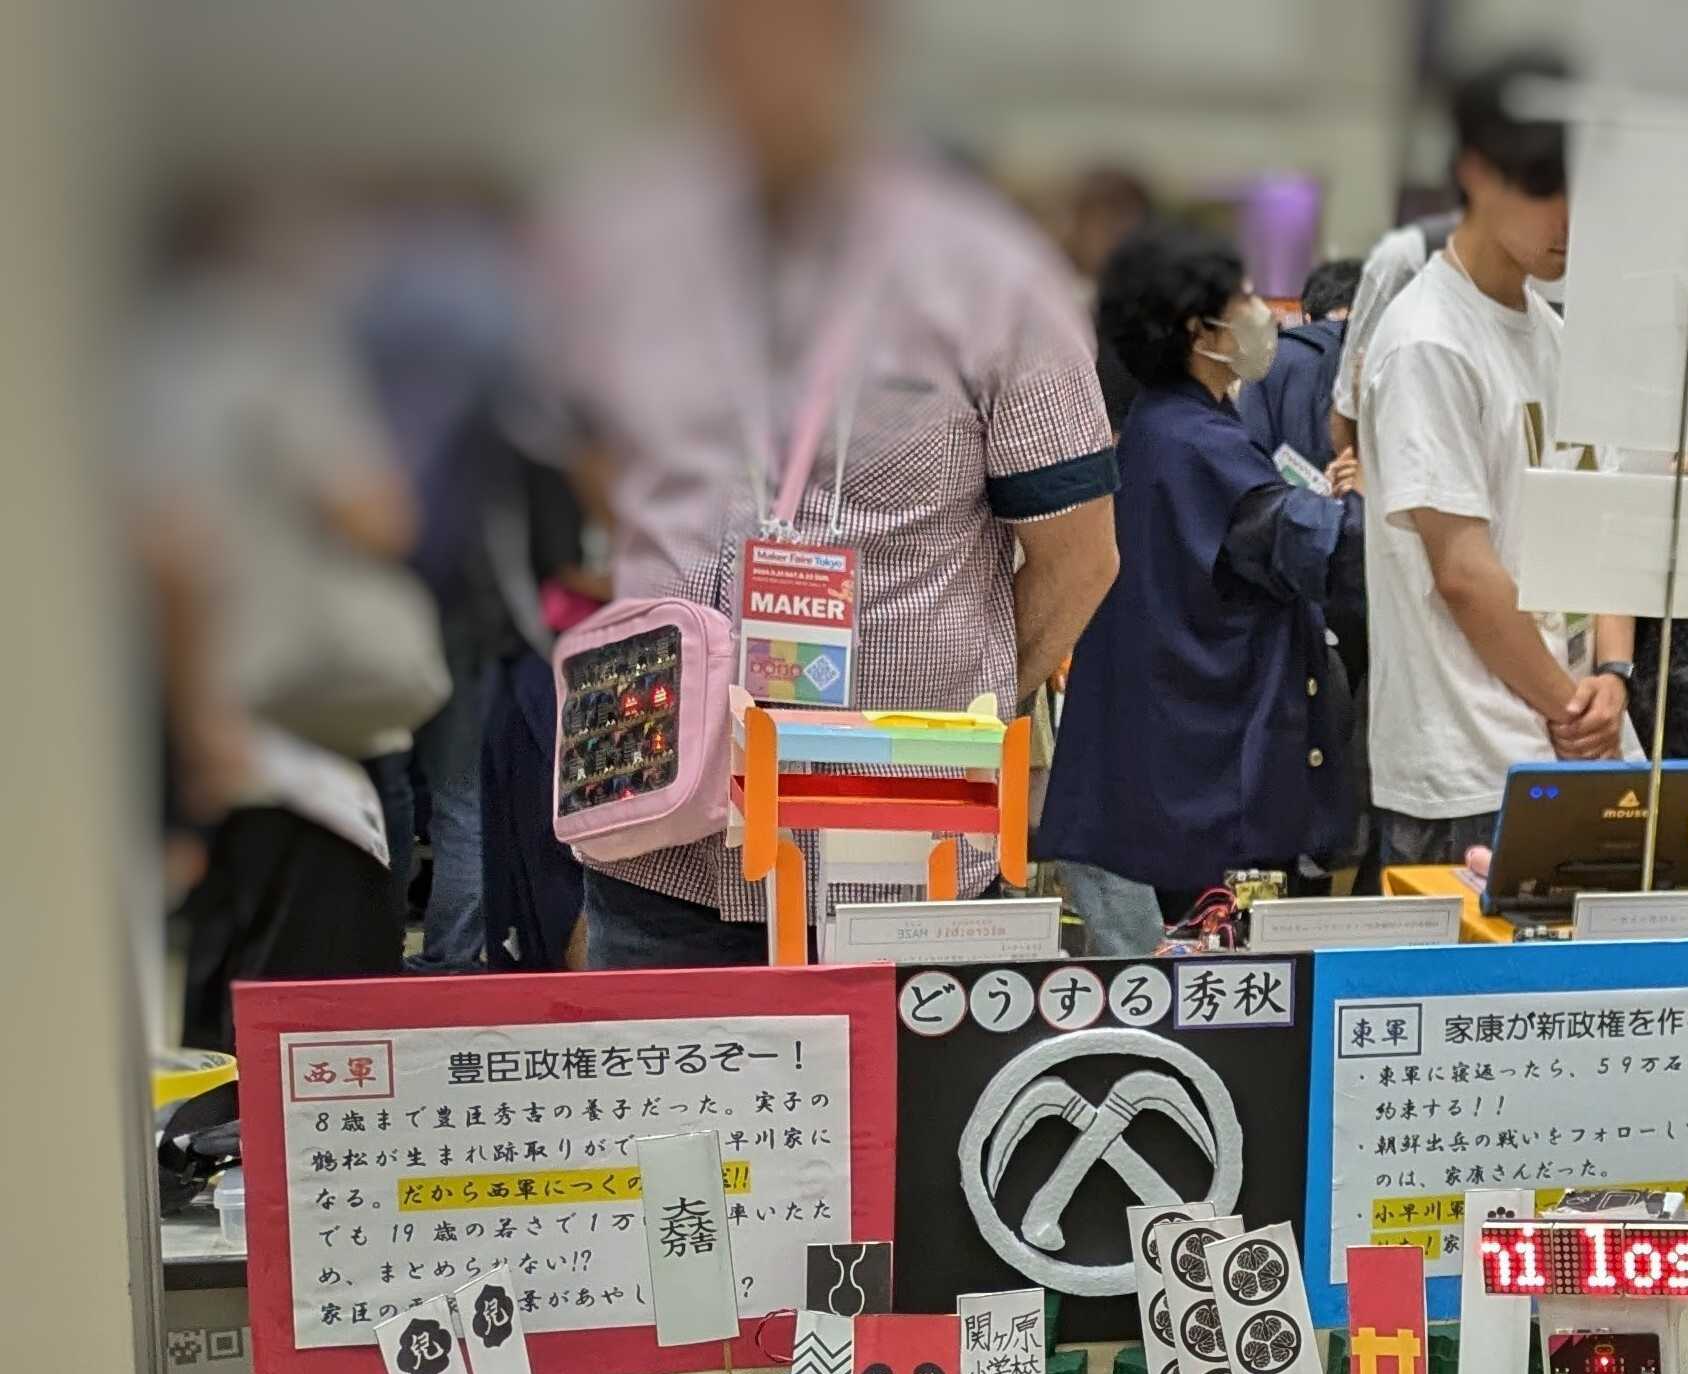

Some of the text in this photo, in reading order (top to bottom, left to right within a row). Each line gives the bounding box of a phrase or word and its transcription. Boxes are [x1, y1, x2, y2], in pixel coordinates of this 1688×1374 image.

[751, 592, 845, 620] MAKER
[1351, 1017, 1409, 1047] 東軍
[303, 1056, 378, 1086] 西軍
